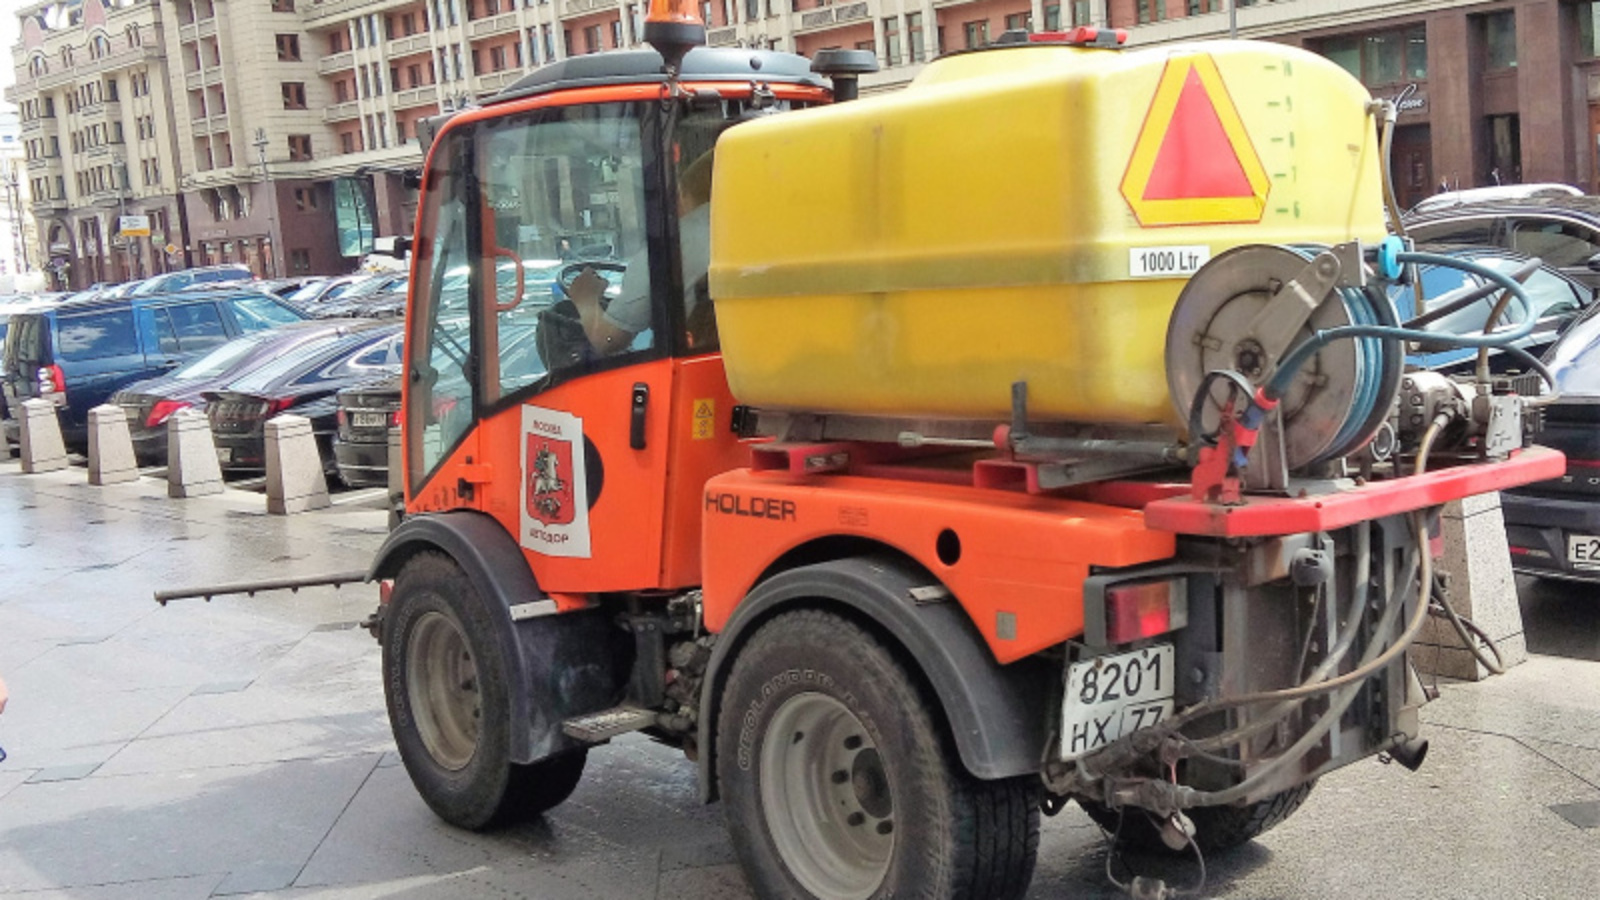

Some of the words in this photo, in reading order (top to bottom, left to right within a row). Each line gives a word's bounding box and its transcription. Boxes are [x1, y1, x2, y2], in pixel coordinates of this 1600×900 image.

[1140, 251, 1175, 272] 1000
[1179, 251, 1199, 271] Ltr
[705, 491, 797, 521] HOLDER
[1080, 653, 1161, 704] 8201
[1131, 706, 1164, 734] 77
